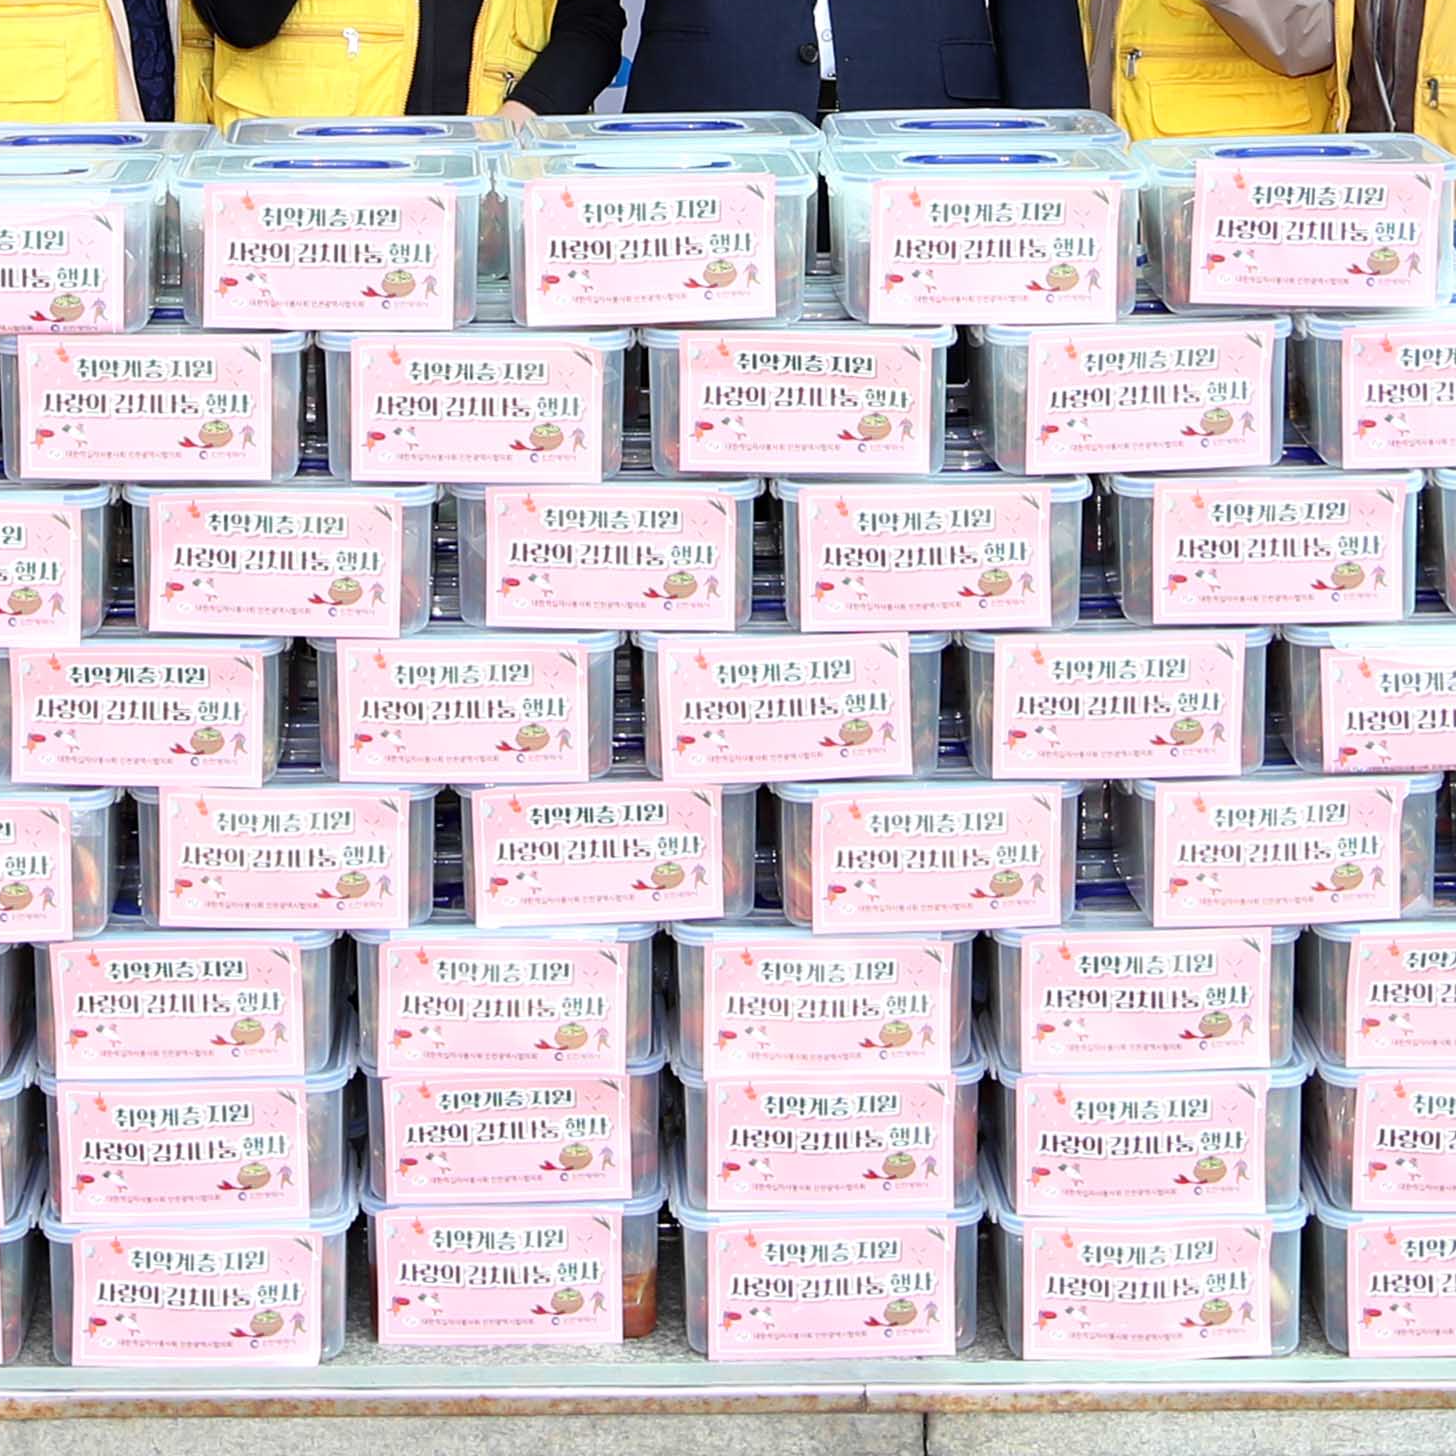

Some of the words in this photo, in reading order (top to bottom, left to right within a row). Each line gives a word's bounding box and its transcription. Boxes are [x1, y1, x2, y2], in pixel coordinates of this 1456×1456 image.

[261, 206, 348, 228] 취약계층
[355, 207, 398, 228] 지원
[928, 203, 1014, 223] 취약계층
[1020, 202, 1063, 222] 지원
[22, 229, 66, 251] 지원
[895, 236, 957, 258] 사랑의
[962, 237, 1047, 259] 김치나눔
[1053, 235, 1098, 257] 행사
[228, 239, 291, 263] 사랑의
[296, 241, 383, 265] 김치나눔
[388, 241, 434, 264] 행사
[56, 264, 102, 287] 행사
[76, 358, 164, 379] 취약계층
[171, 358, 214, 379] 지원
[44, 391, 107, 414] 사랑의
[113, 392, 199, 415] 김치나눔
[205, 391, 251, 414] 행사
[1367, 380, 1429, 403] 사랑의
[543, 508, 630, 530] 취약계층
[637, 510, 680, 531] 지원
[511, 540, 573, 564] 사랑의
[578, 542, 665, 566] 김치나눔
[670, 543, 716, 566] 행사
[69, 664, 156, 686] 취약계층
[163, 666, 207, 687] 지원
[1051, 660, 1138, 680] 취약계층
[1144, 659, 1188, 678] 지원
[36, 696, 99, 719] 사랑의
[105, 698, 191, 722] 김치나눔
[197, 699, 243, 721] 행사
[1018, 693, 1080, 715] 사랑의
[1085, 692, 1172, 714] 김치나눔
[1177, 690, 1223, 712] 행사
[529, 805, 615, 826] 취약계층
[623, 803, 665, 823] 지원
[498, 839, 560, 861] 사랑의
[566, 837, 651, 860] 김치나눔
[657, 834, 702, 856] 행사
[435, 961, 522, 982] 취약계층
[528, 962, 571, 982] 지원
[403, 993, 465, 1016] 사랑의
[470, 995, 556, 1018] 김치나눔
[561, 995, 606, 1017] 행사
